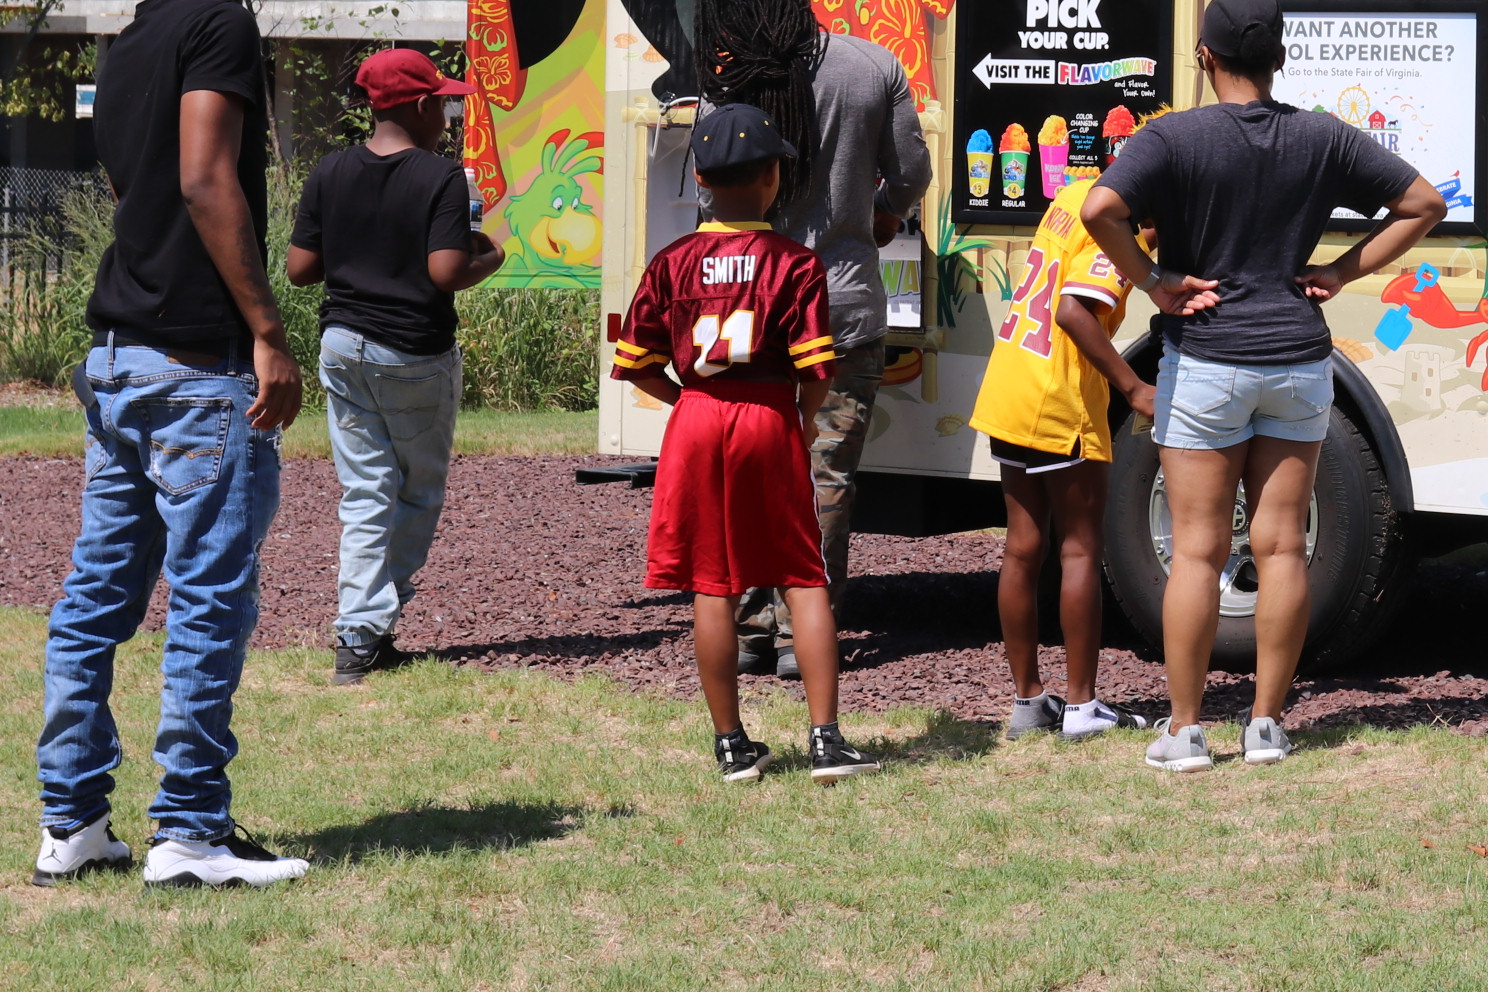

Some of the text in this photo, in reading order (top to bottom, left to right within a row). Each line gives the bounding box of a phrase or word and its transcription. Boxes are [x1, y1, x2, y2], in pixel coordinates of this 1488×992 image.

[1283, 21, 1438, 38] WANT ANOTHER
[1018, 31, 1109, 49] YOUR CUP.
[1320, 44, 1455, 62] EXPERIENCE?
[986, 57, 1156, 85] VISIT THE FLAVORWAVE
[1288, 67, 1422, 79] Go to the State Fair of Virginia.
[1114, 80, 1125, 88] and
[1368, 130, 1400, 152] AIR
[1002, 199, 1026, 207] REGULAR
[702, 255, 756, 285] SMITH
